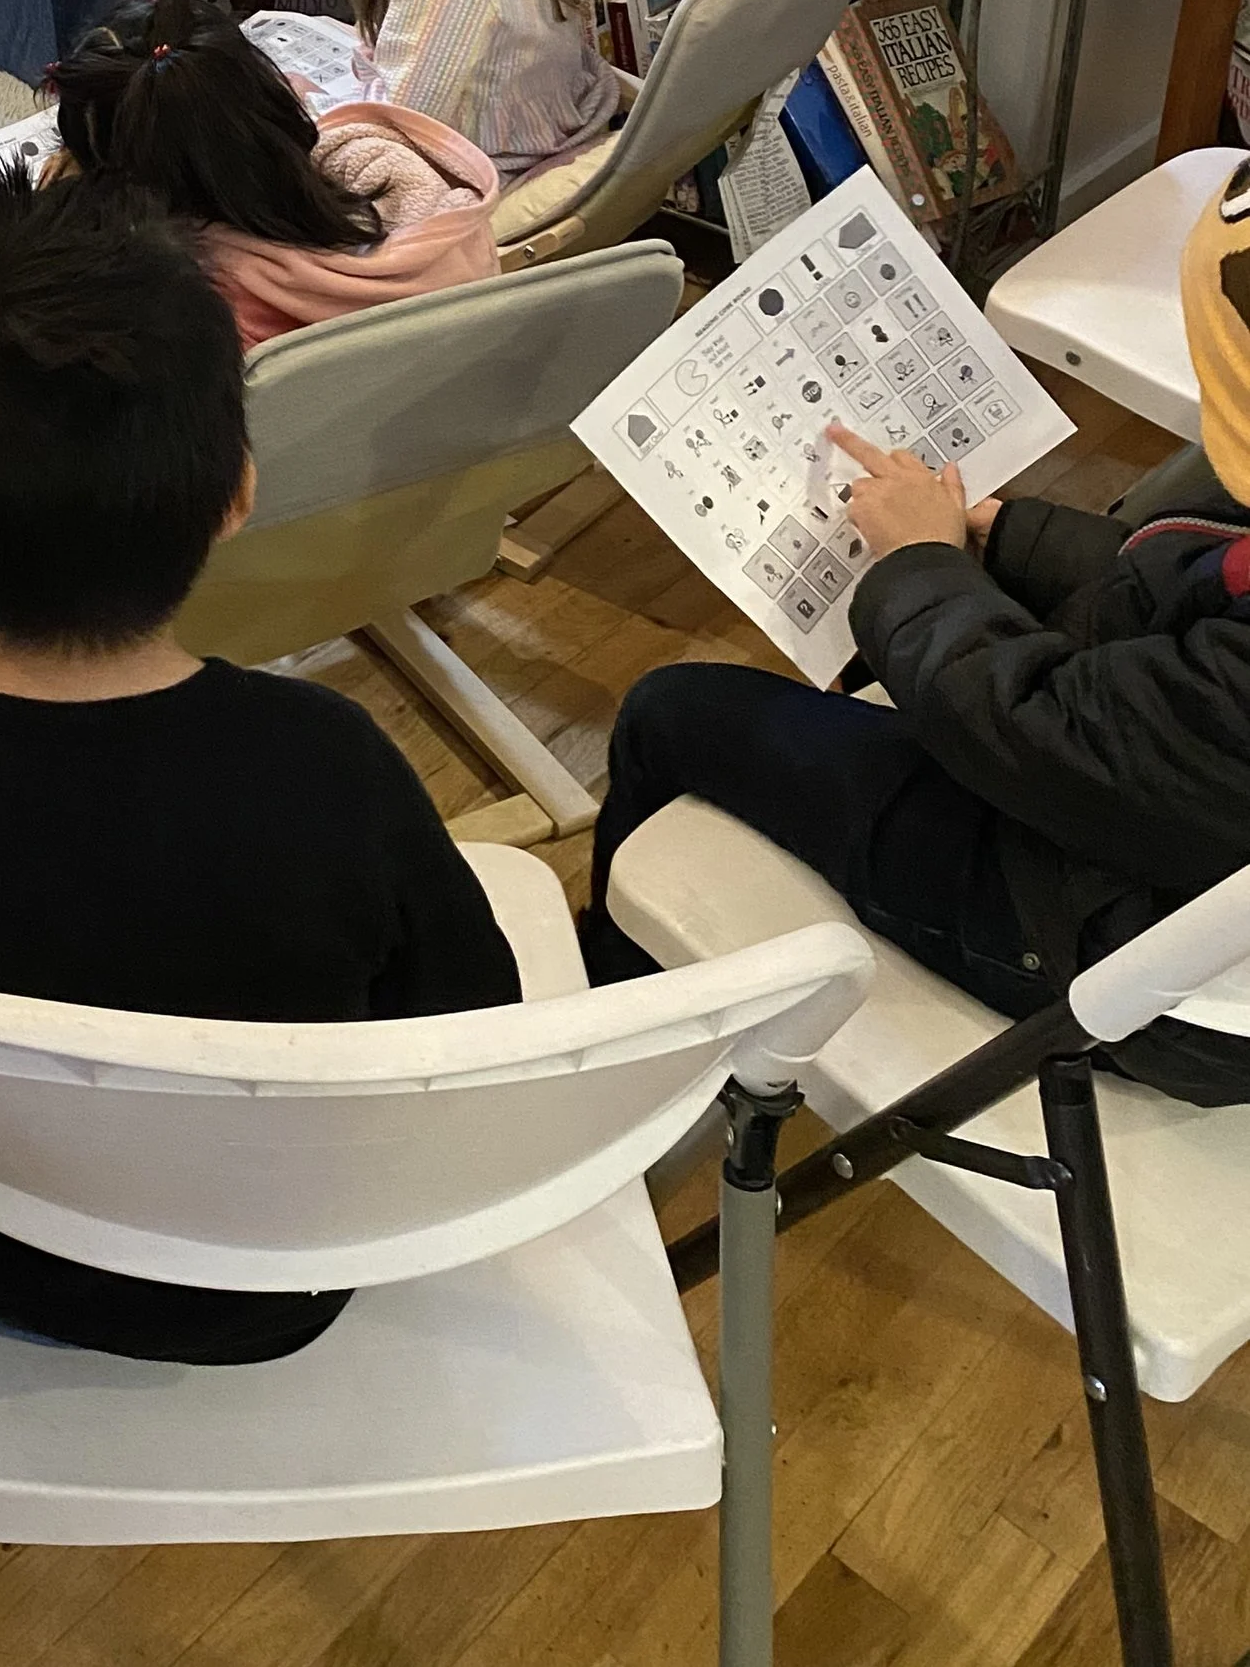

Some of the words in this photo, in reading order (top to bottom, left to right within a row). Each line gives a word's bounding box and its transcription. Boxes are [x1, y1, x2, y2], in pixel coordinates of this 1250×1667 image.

[874, 22, 901, 43] 365
[902, 8, 941, 33] EASY
[882, 31, 952, 69] ITALIAN
[897, 55, 956, 88] RECIPES
[802, 384, 821, 400] STOP
